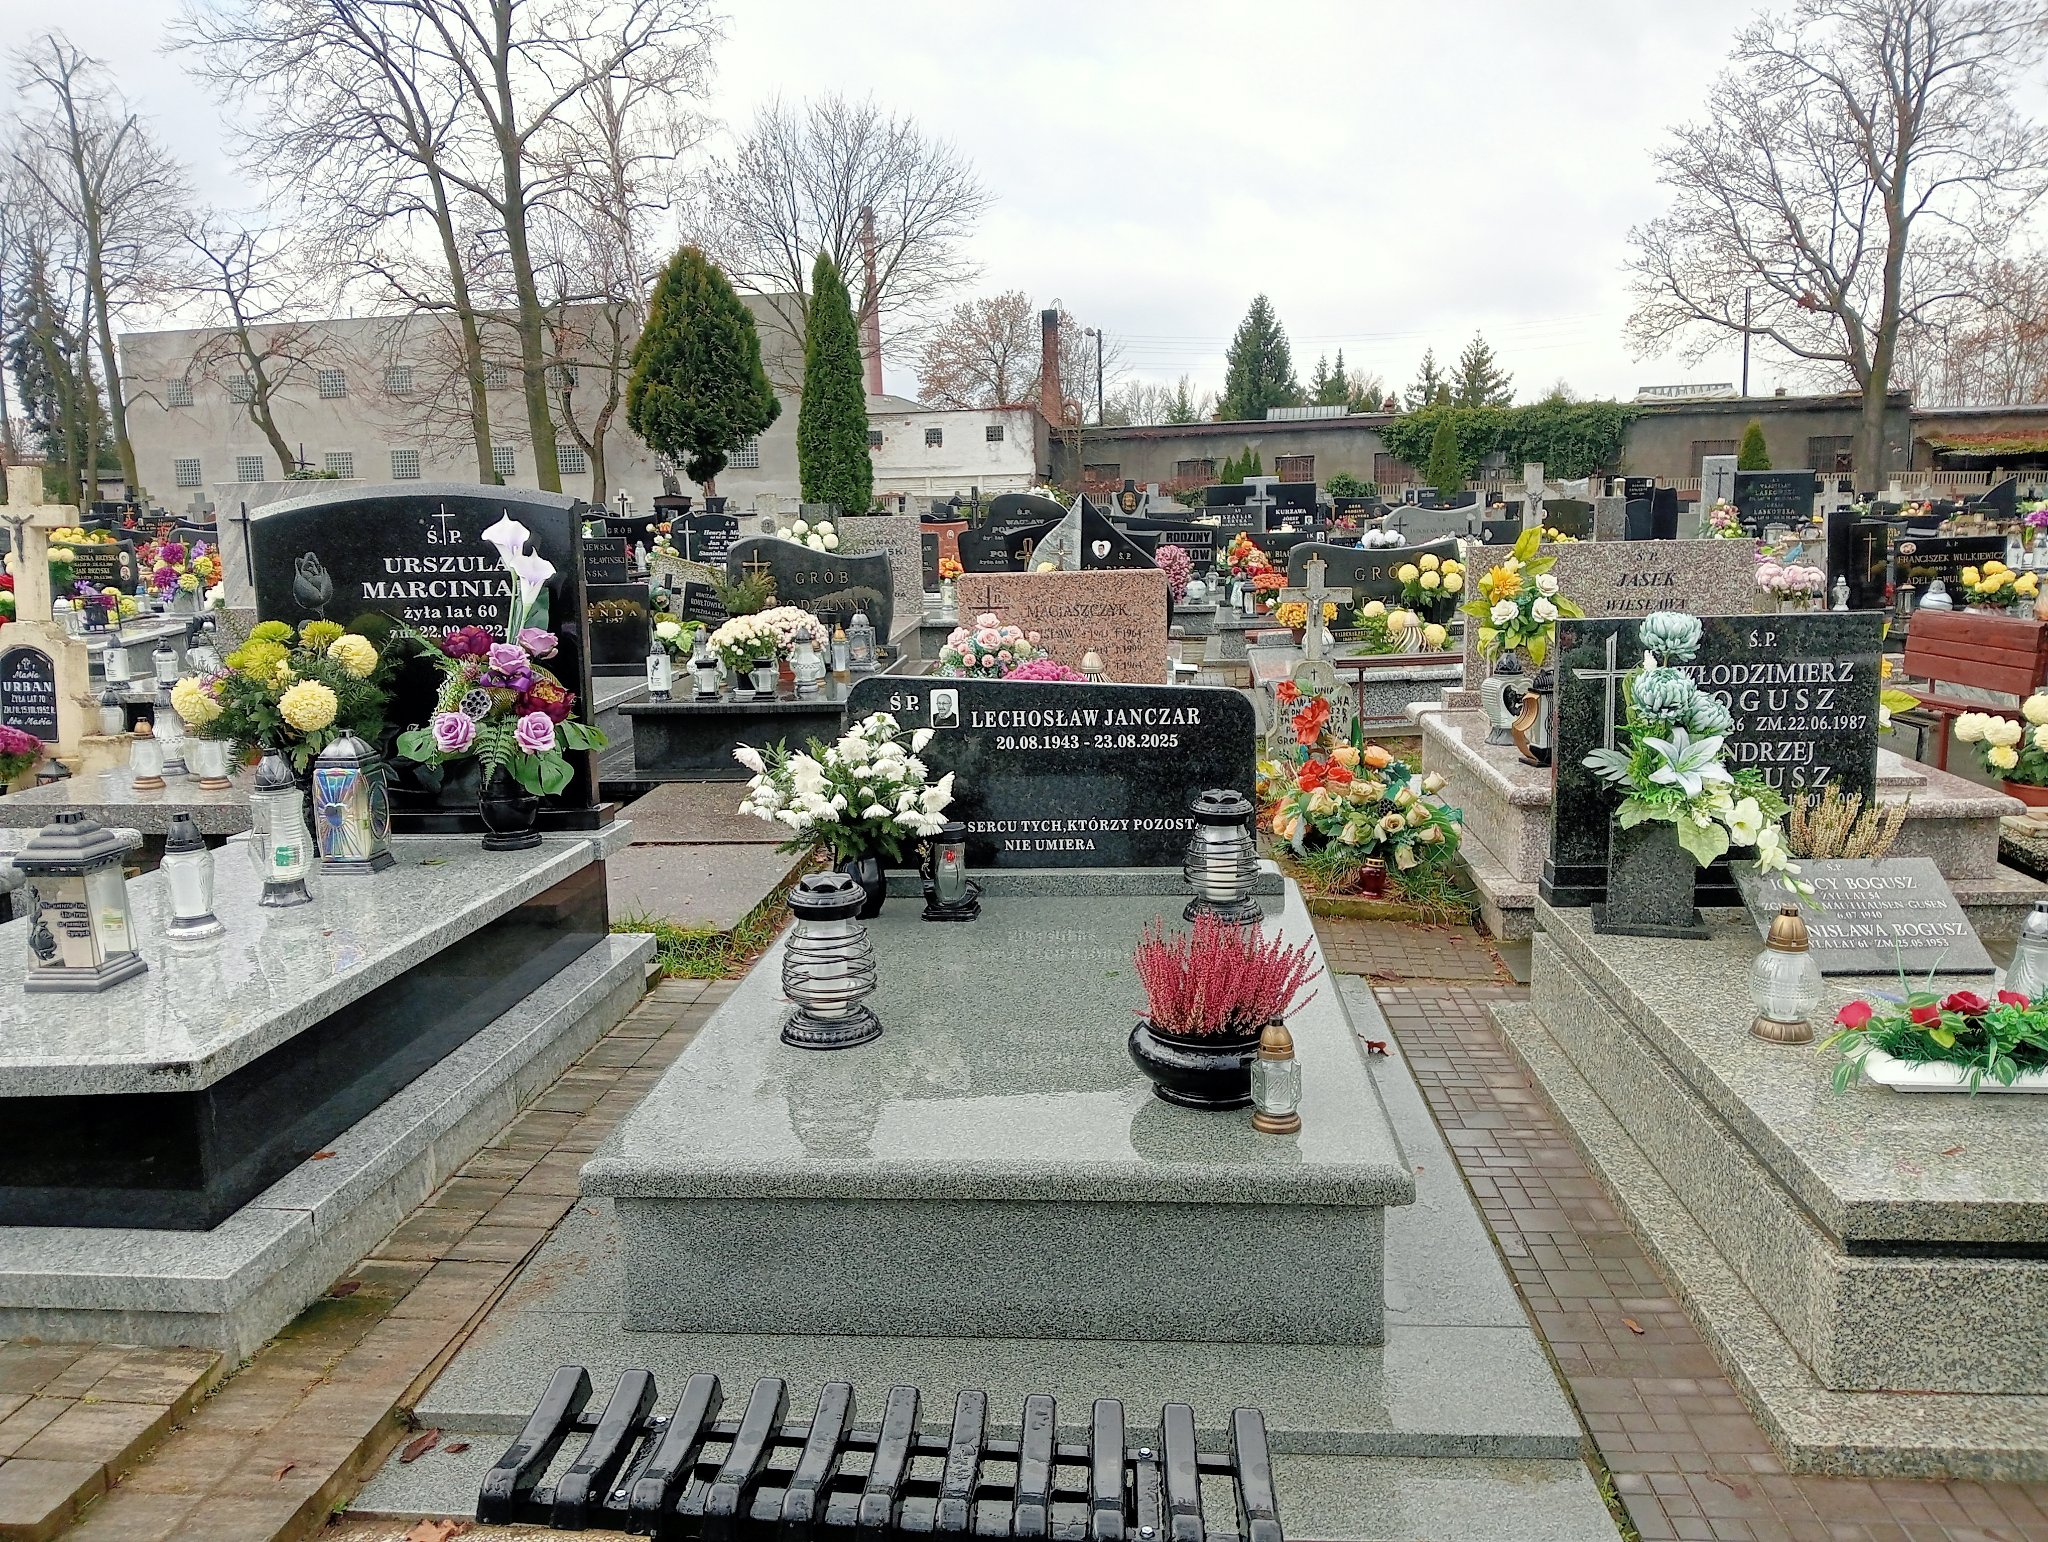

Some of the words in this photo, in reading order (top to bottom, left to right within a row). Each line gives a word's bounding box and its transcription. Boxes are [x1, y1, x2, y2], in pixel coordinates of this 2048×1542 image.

[1166, 532, 1210, 543] RODZINY
[1898, 553, 1950, 564] FRANCISZEK
[1953, 551, 2006, 561] WULKIEWICZ
[383, 556, 511, 574] URSZULA
[795, 569, 849, 584] GRÓB
[361, 579, 520, 599] MARCINIA
[404, 605, 442, 621] żyła
[446, 604, 472, 618] lat
[477, 605, 498, 618] 60
[588, 609, 637, 617] ENDA
[3, 681, 52, 692] URBAN
[27, 694, 37, 703] LAT
[38, 694, 46, 703] 70
[1713, 688, 1835, 711] OGUSZ
[971, 710, 1099, 728] LECHOSŁAW
[1104, 708, 1201, 726] JANCZAR
[1755, 715, 1867, 732] ZM.22.06.1987
[996, 735, 1080, 749] 20.08.1943
[1094, 733, 1179, 748] 23.08.2025
[1721, 741, 1816, 765] NDRZEJ
[968, 820, 1018, 833] SERCU
[1005, 839, 1031, 851] NIE
[1035, 838, 1096, 851] UMIERA
[1846, 877, 1918, 890] BOGUSZ
[1869, 891, 1880, 900] 54
[1896, 922, 1968, 936] BOGUSZ
